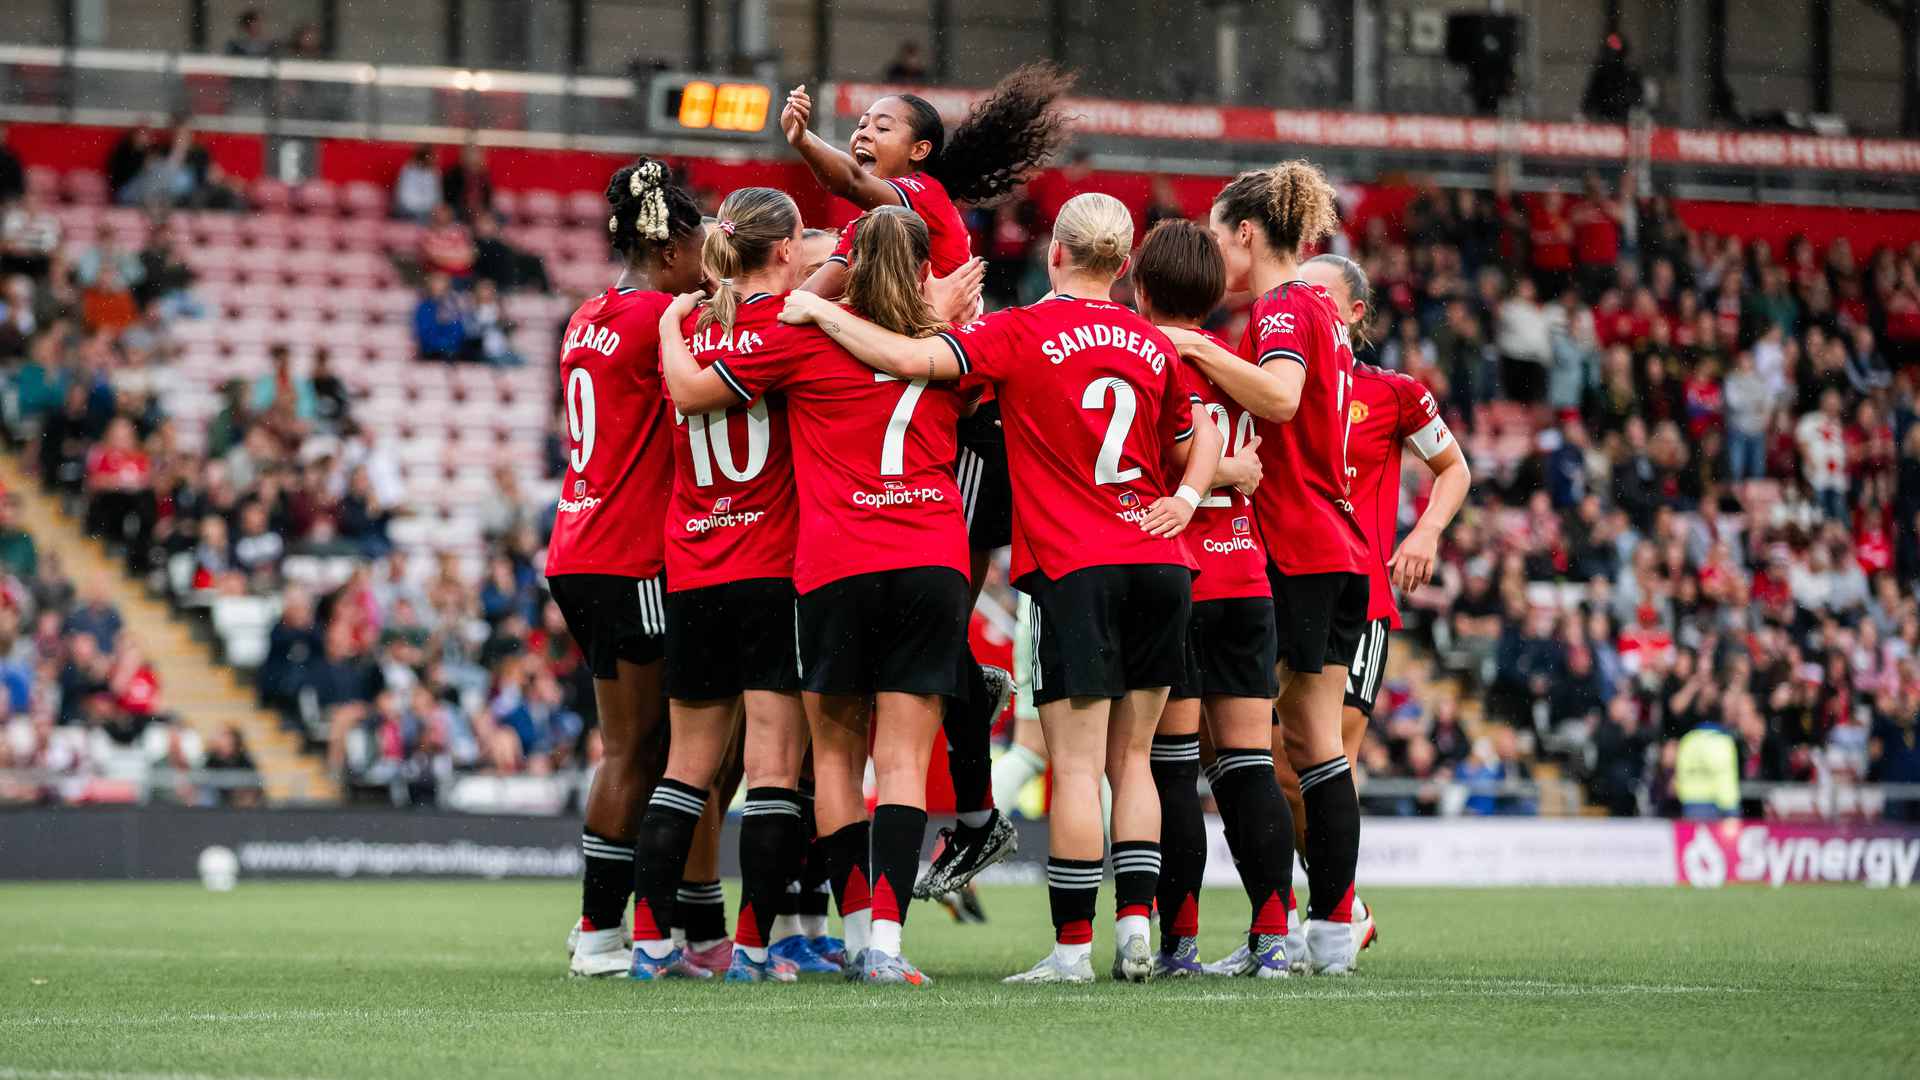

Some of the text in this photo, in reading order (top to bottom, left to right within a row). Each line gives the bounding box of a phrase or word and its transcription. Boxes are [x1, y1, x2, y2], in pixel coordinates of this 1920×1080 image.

[1041, 324, 1166, 376] SANDBERG
[568, 367, 596, 473] 9
[675, 400, 770, 487] 10
[874, 373, 929, 476] 7
[1081, 376, 1142, 486] 2
[852, 487, 944, 509] Copilot+PC
[1736, 825, 1920, 889] Synergy
